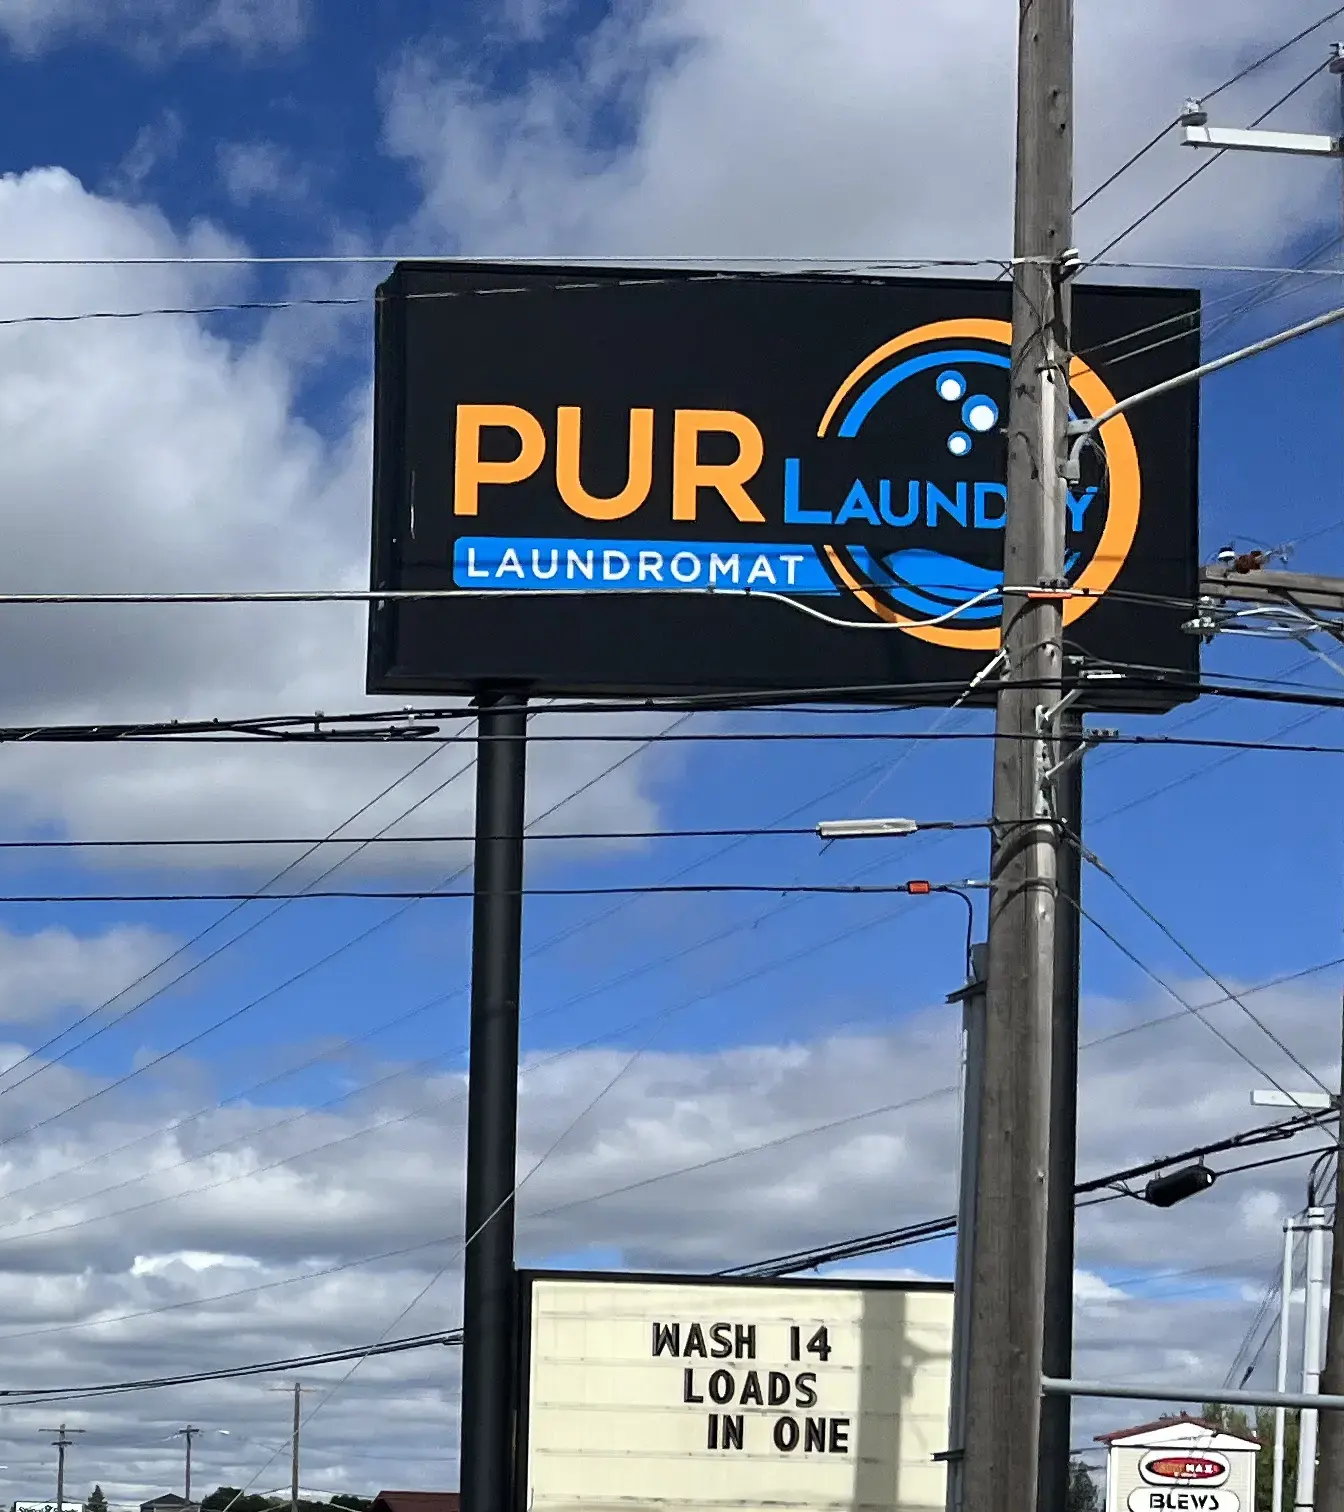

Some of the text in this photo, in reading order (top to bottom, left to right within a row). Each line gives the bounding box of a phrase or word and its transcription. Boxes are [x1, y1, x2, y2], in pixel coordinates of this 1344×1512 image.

[454, 404, 1098, 532] PUR LAUNDY
[466, 547, 804, 585] LAUNDROMAT
[652, 1322, 831, 1361] WASH 14
[683, 1368, 818, 1408] LOADS
[707, 1413, 850, 1453] IN ONE
